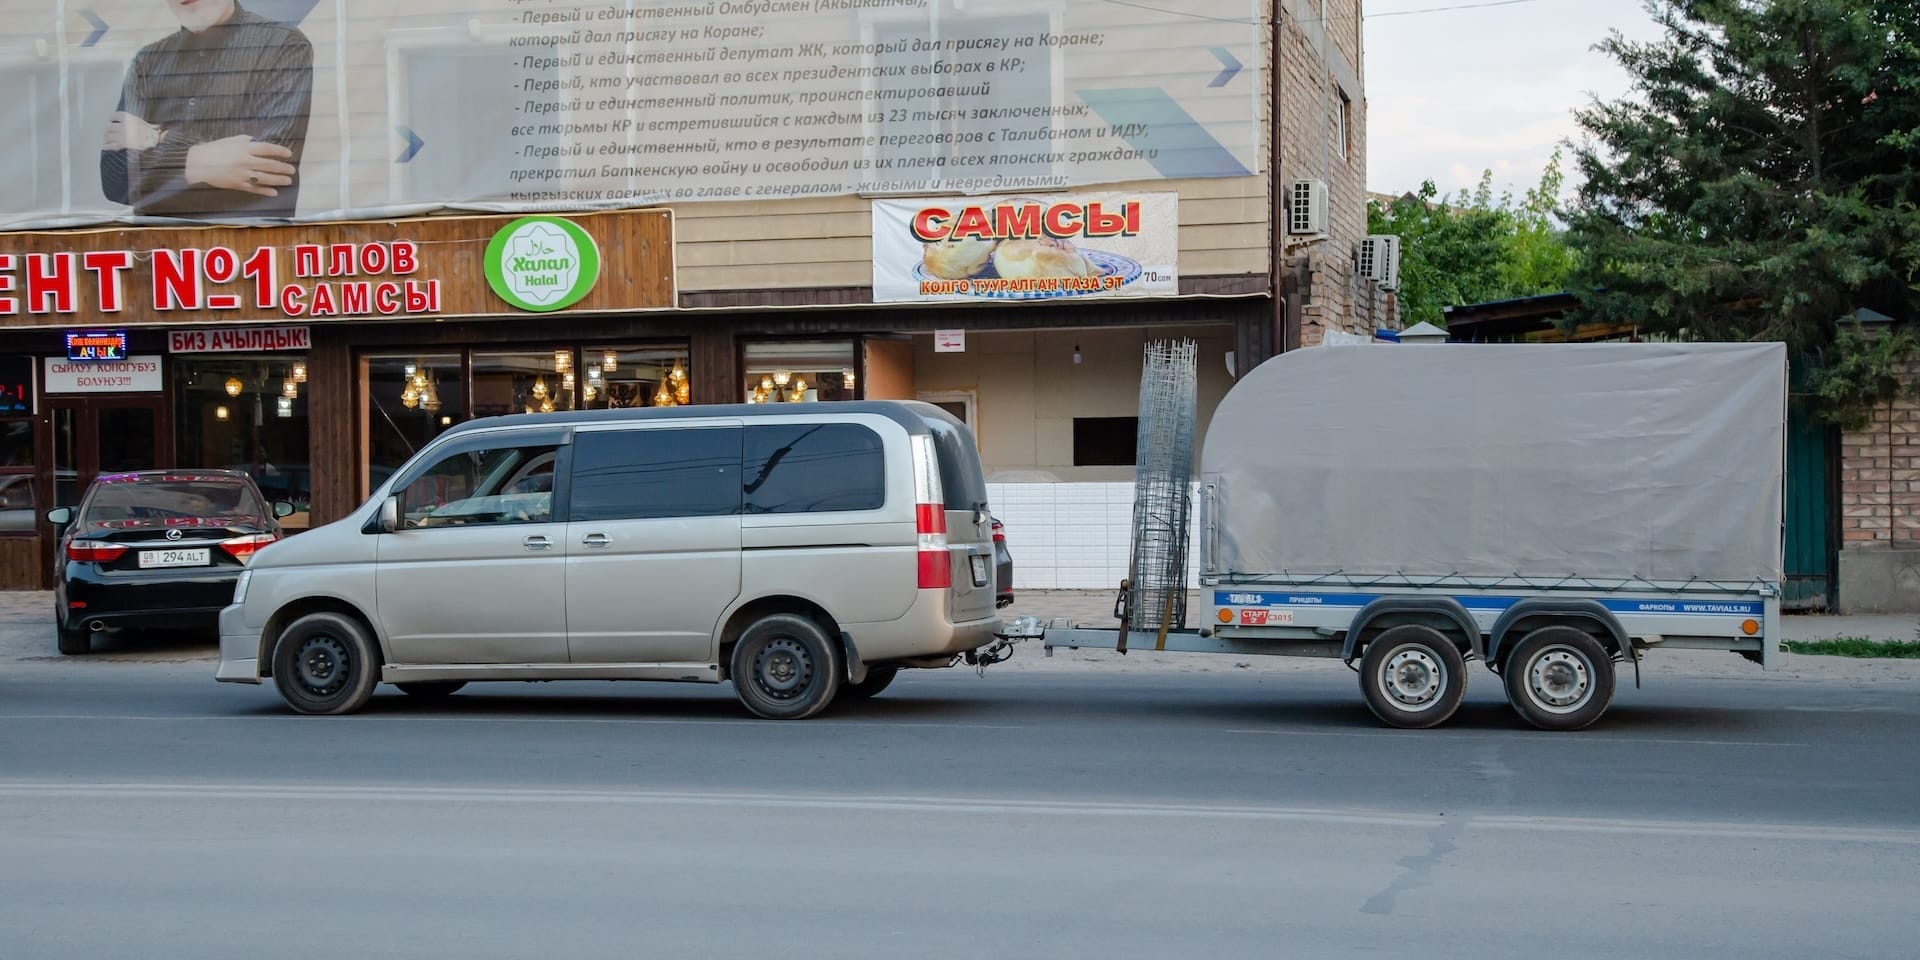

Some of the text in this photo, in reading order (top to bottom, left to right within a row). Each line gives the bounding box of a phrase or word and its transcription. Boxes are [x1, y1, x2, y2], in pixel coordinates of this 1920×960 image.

[523, 8, 580, 26] Первый
[585, 11, 594, 20] и
[598, 6, 715, 20] единственный
[719, 0, 809, 17] Омбудсмен
[509, 26, 765, 48] который дал присягу на Коране;
[523, 53, 581, 71] Первый
[585, 56, 594, 65] и
[598, 51, 715, 65] единственный
[719, 47, 793, 62] депутат
[799, 43, 827, 58] ЖК,
[833, 38, 907, 56] который
[912, 39, 941, 51] дал
[946, 39, 1009, 50] присягу
[1014, 36, 1033, 47] на
[1039, 33, 1104, 48] Коране;
[524, 76, 584, 93] Первый,
[590, 77, 621, 87] кто
[626, 75, 719, 89] участвовал
[724, 73, 741, 83] во
[746, 71, 778, 82] всех
[783, 65, 906, 82] президентских
[911, 60, 981, 77] выборах
[986, 62, 994, 71] в
[1000, 58, 1025, 73] КР;
[524, 100, 581, 115] Первый
[586, 101, 594, 110] и
[599, 97, 715, 110] единственный
[720, 93, 794, 106] политик,
[800, 81, 990, 105] проинспектировавший
[512, 105, 1089, 136] все тюрьмы КР и встретившийся с каждым из 23 тысяч заключенных;
[524, 144, 581, 159] Первый
[586, 146, 594, 155] и
[599, 142, 720, 153] единственный,
[725, 140, 757, 150] кто
[762, 140, 770, 149] в
[774, 136, 875, 152] результате
[879, 132, 983, 147] переговоров
[988, 131, 996, 141] с
[1000, 126, 1091, 141] Талибаном
[1097, 127, 1105, 138] и
[1111, 122, 1149, 139] ИДУ,
[510, 147, 1158, 182] прекратил Баткенскую войну и освободил из их плена всех японских граждан и
[511, 190, 602, 201] кыргызских
[675, 188, 693, 198] во
[697, 186, 741, 197] главе
[745, 186, 753, 195] с
[756, 183, 841, 196] генералом
[856, 179, 926, 191] живыми
[931, 179, 940, 189] и
[945, 174, 1069, 190] невредимыми;
[911, 201, 1141, 241] САМСЫ
[295, 242, 419, 277] ПЛОВ
[513, 256, 569, 272] Халал
[525, 274, 558, 286] Halal
[920, 276, 1125, 295] КОЛГО ТУУРАЛГАН ТАЗА ЭТ
[281, 280, 440, 317] САМСЫ
[80, 346, 115, 357] АЧЫК
[172, 328, 308, 351] БИЗ АЧЫЛДЫК!
[163, 552, 184, 562] 294
[186, 552, 205, 561] ALT
[1242, 610, 1267, 618] СТАРТ
[1683, 604, 1751, 612] WWW.TAVIALS.RU
